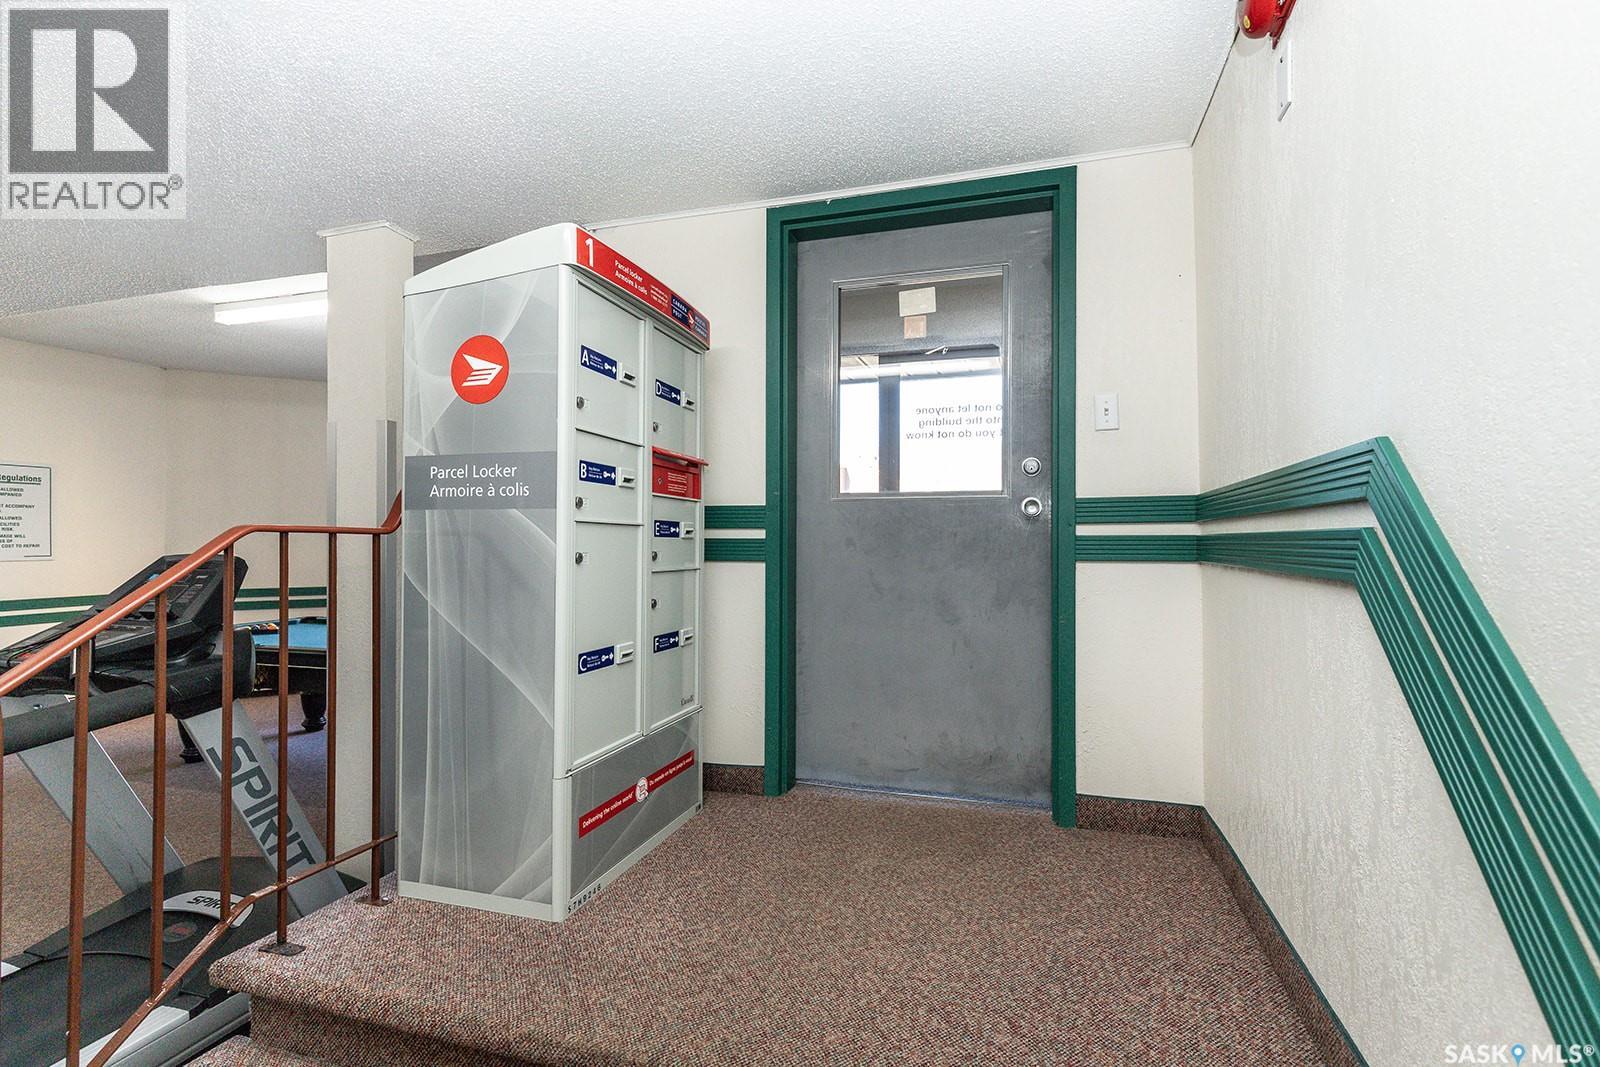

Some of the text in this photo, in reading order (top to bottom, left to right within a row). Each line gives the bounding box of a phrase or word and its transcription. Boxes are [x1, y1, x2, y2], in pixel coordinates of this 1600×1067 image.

[585, 238, 594, 268] 1
[582, 349, 589, 365] A
[656, 382, 662, 395] D
[430, 463, 518, 479] Parcel Locker
[580, 463, 587, 478] B
[429, 482, 530, 497] Armoire à colis
[655, 522, 660, 536] E
[655, 637, 660, 652] F
[580, 656, 587, 671] C
[206, 737, 316, 872] SPIRIT
[186, 896, 236, 910] SPIR
